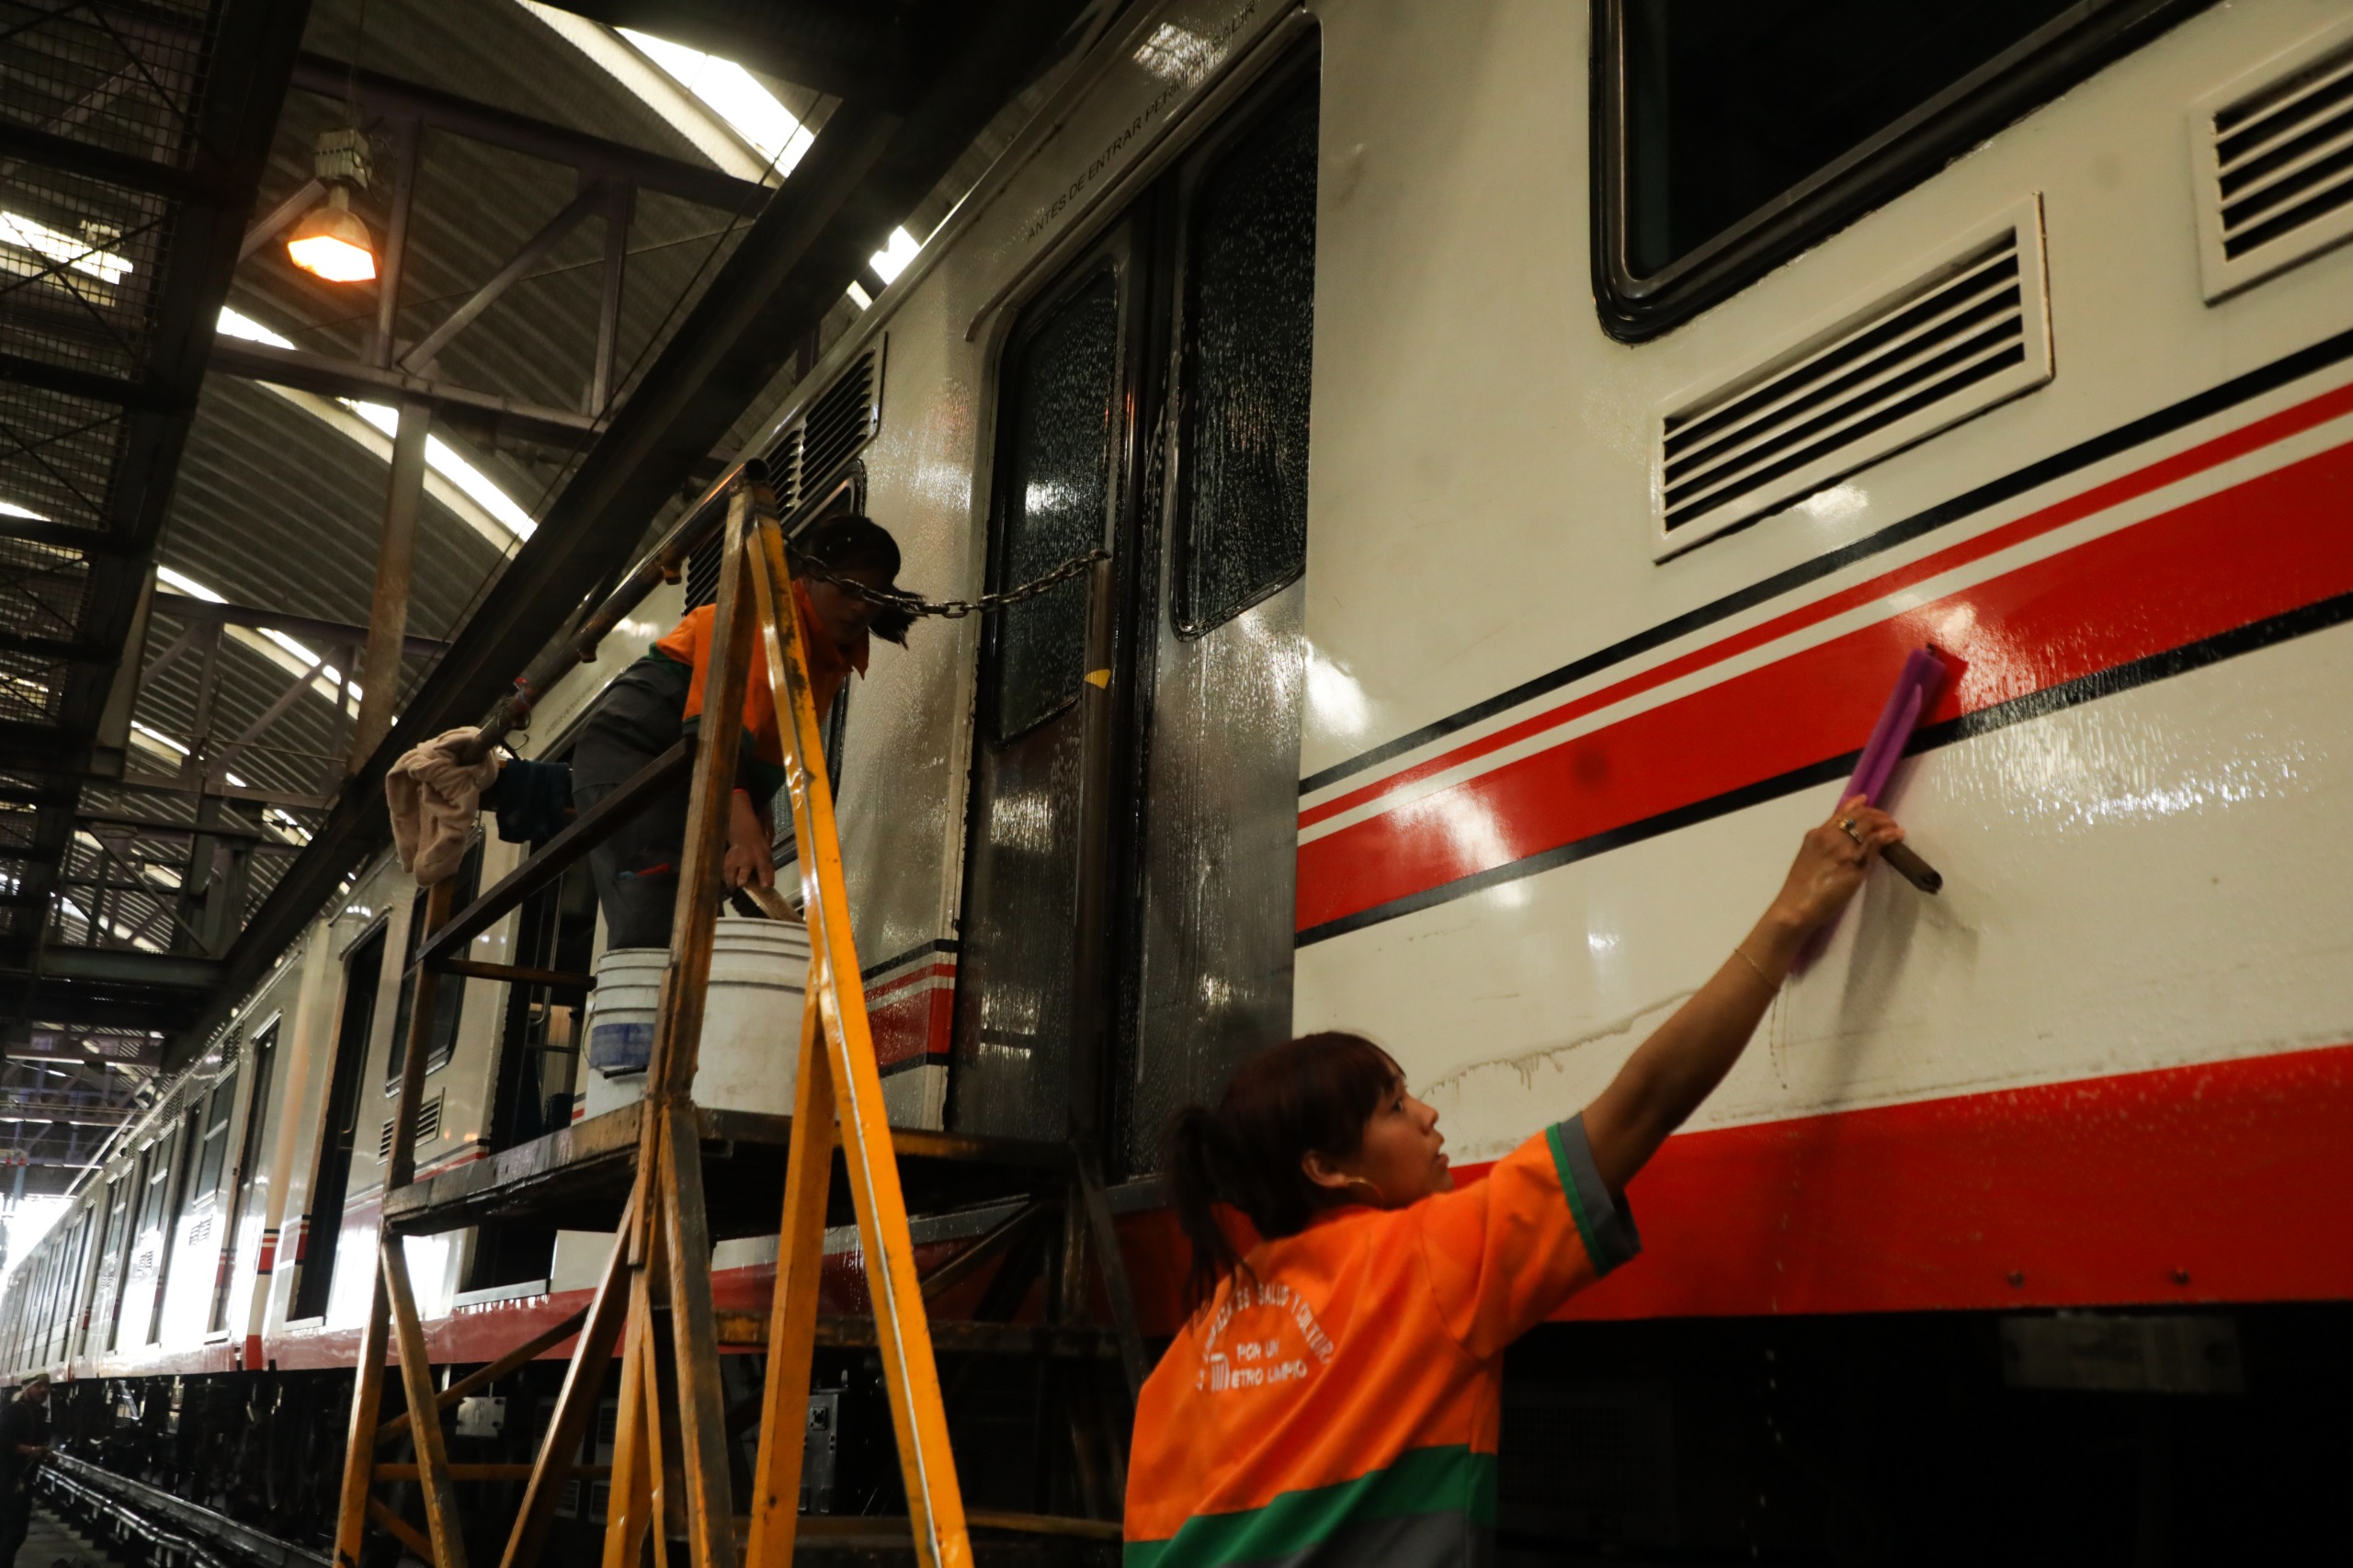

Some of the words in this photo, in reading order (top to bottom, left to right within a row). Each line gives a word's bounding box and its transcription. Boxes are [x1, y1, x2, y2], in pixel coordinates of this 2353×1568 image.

[1027, 194, 1066, 243] ANTES
[1069, 173, 1086, 200] DE
[1088, 116, 1142, 181] ENTRAR
[1236, 1342, 1261, 1361] POR
[1265, 1339, 1279, 1357] UN
